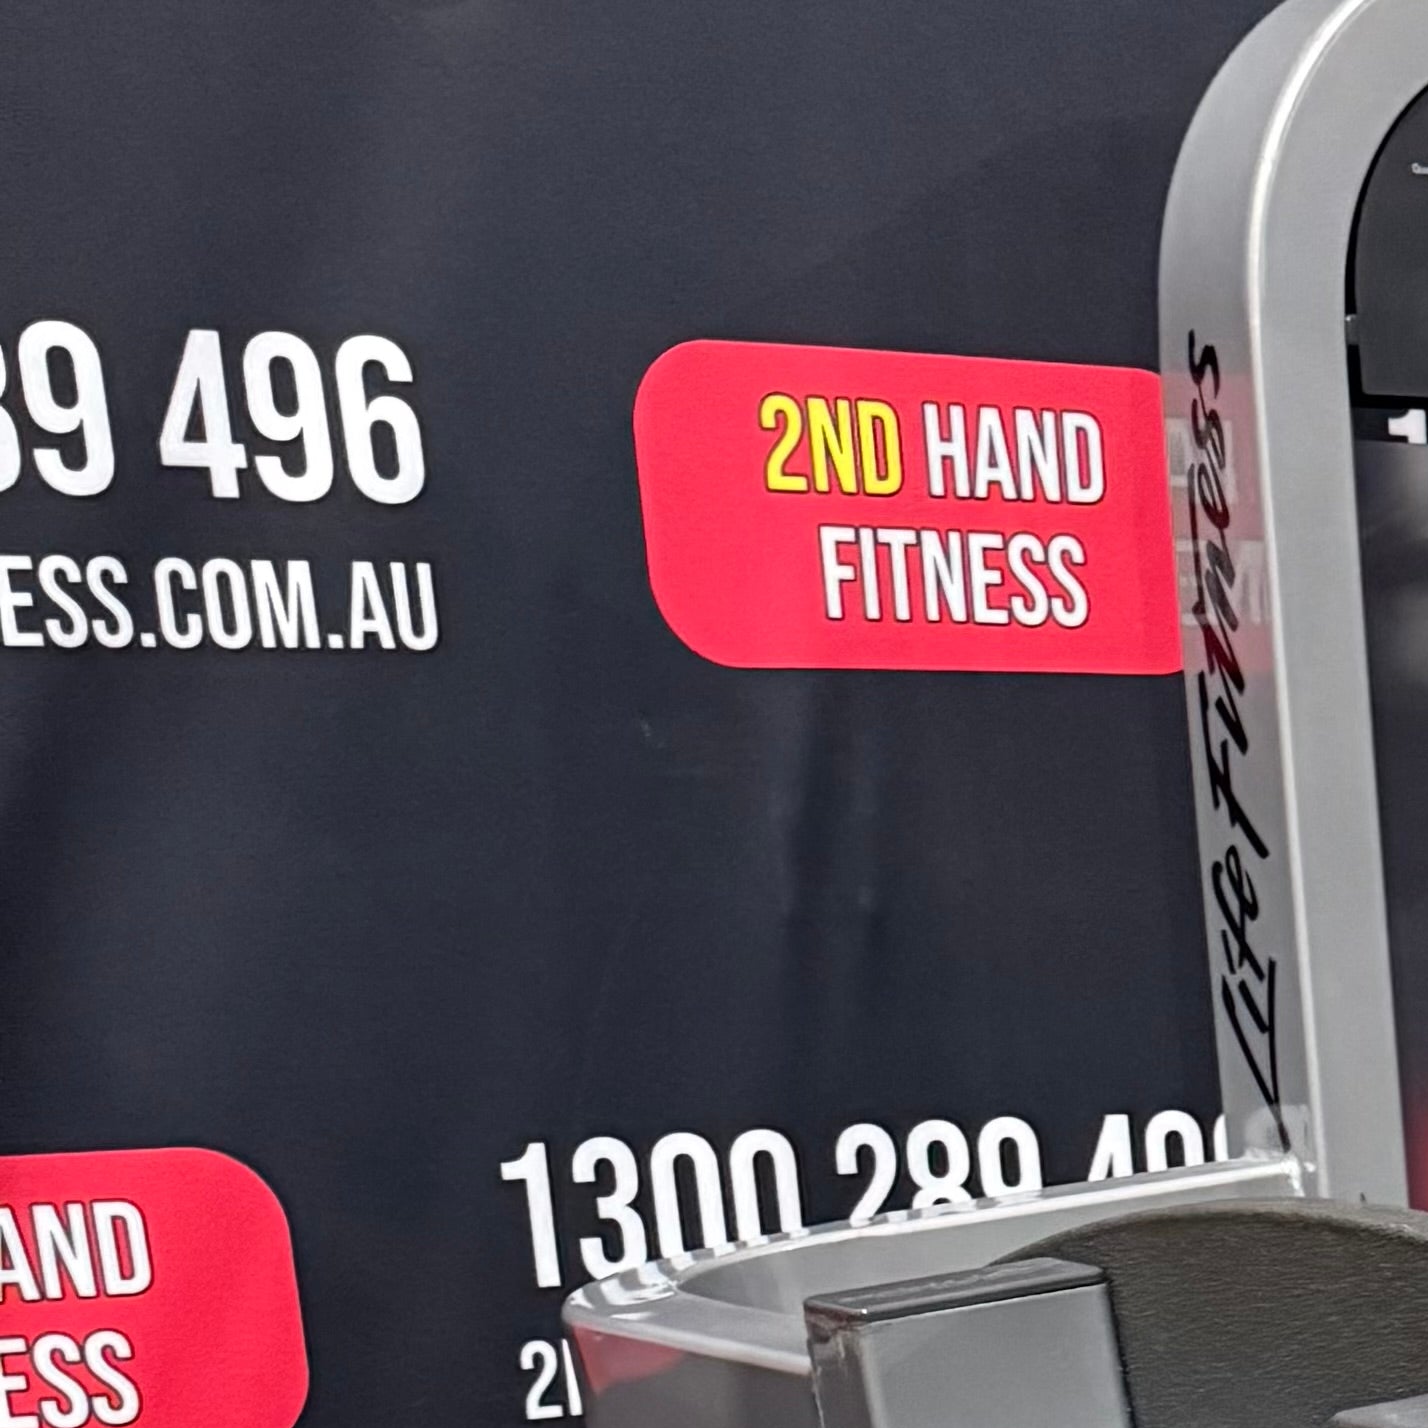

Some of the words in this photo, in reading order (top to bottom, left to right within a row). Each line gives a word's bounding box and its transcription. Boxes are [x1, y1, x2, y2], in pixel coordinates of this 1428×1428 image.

[159, 329, 426, 505] 496
[759, 391, 903, 497] 2ND
[922, 402, 1106, 506] HAND
[818, 524, 1091, 629] FITNESS
